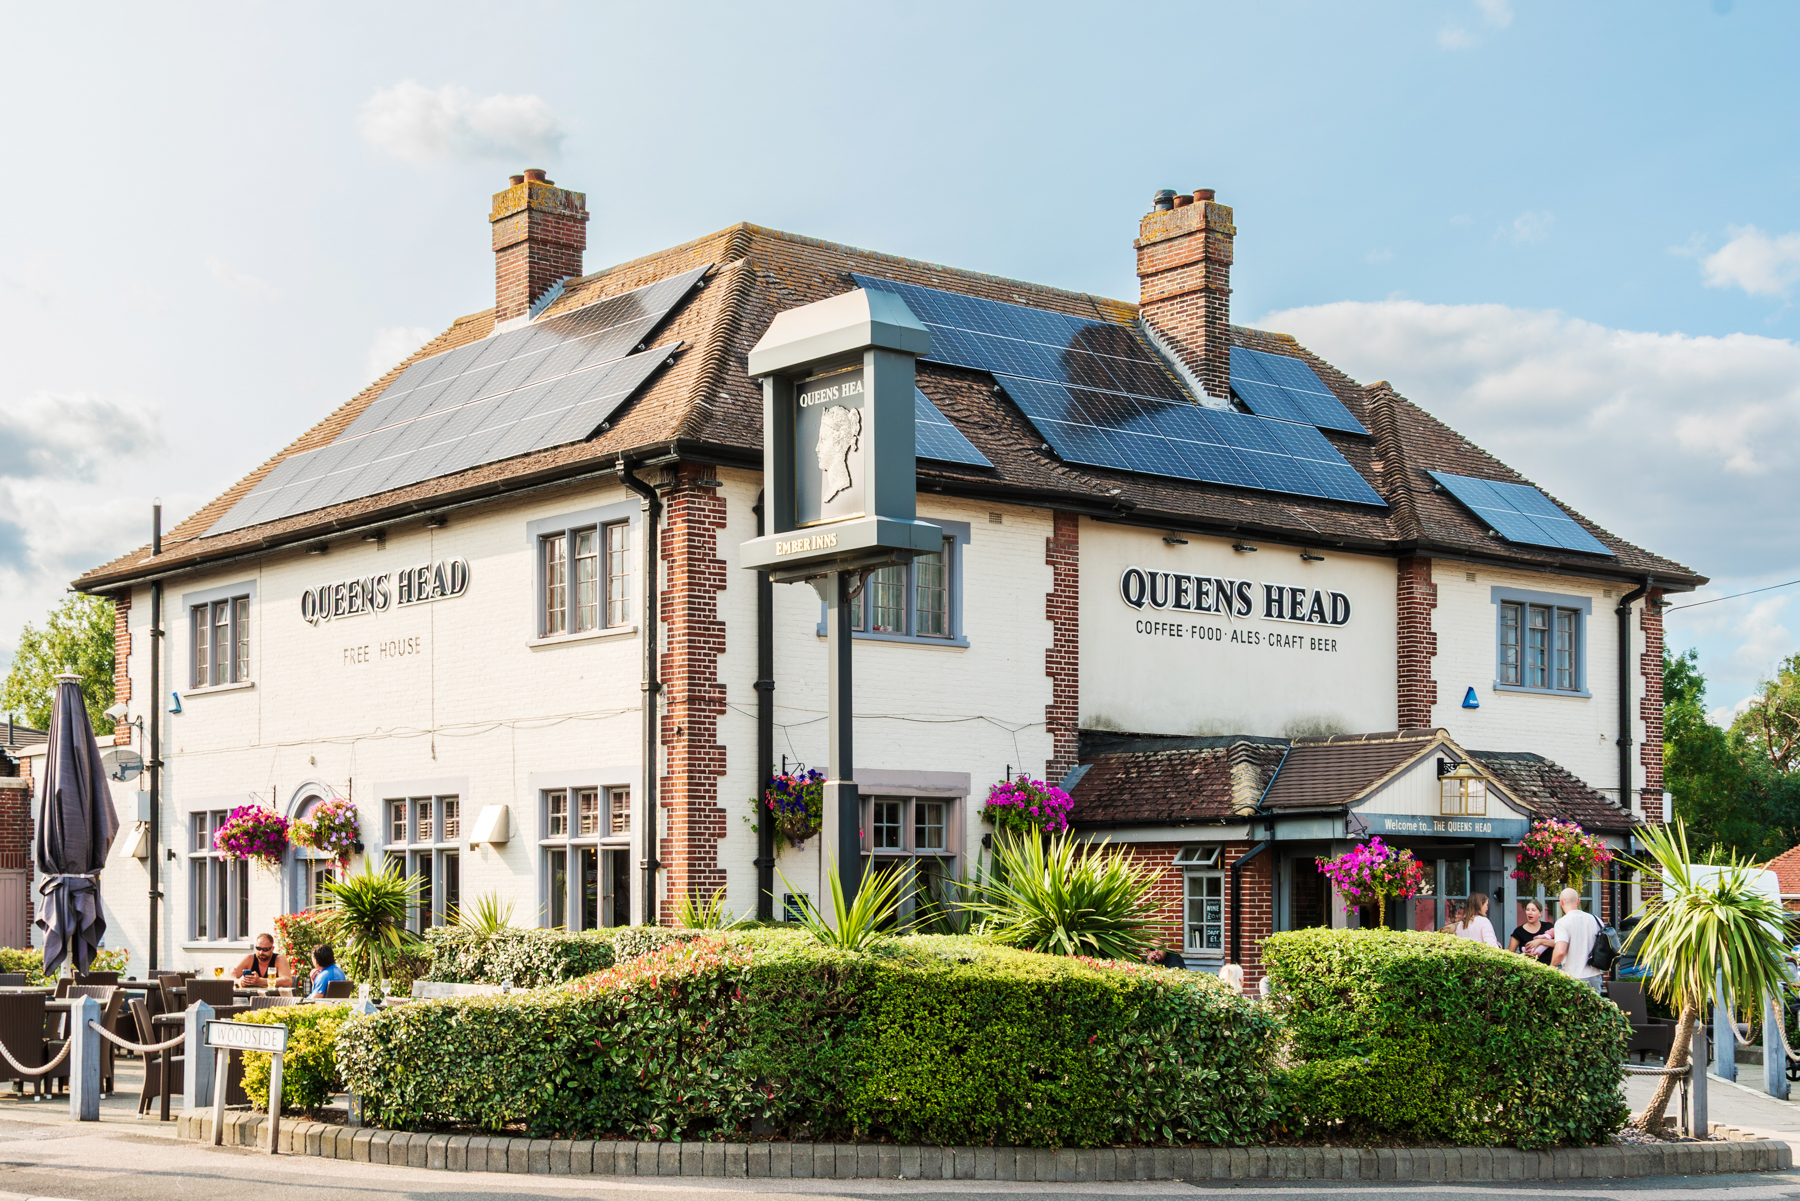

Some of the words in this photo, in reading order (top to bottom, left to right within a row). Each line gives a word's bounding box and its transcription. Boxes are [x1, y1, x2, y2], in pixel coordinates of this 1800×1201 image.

[800, 385, 839, 408] QUEENS
[841, 379, 864, 398] HEA
[775, 538, 811, 556] EMBER
[812, 533, 838, 550] INNS
[301, 572, 391, 627] QUEENS
[396, 556, 470, 608] HEAD
[1121, 566, 1253, 623] QUEENS
[1260, 582, 1352, 628] HEAD
[1136, 620, 1183, 638] COFFEE
[1191, 625, 1222, 641] FOOD
[1231, 629, 1261, 645] ALES
[1268, 632, 1304, 649] CRAFT
[1310, 637, 1338, 652] BEER
[343, 645, 370, 666] FREE
[379, 636, 421, 660] HOUSE
[1384, 818, 1417, 830] Welcome
[1433, 820, 1445, 831] THE
[1448, 822, 1472, 833] QUEENS
[1475, 822, 1492, 833] HEAD
[217, 1026, 277, 1047] WOODSIDE
